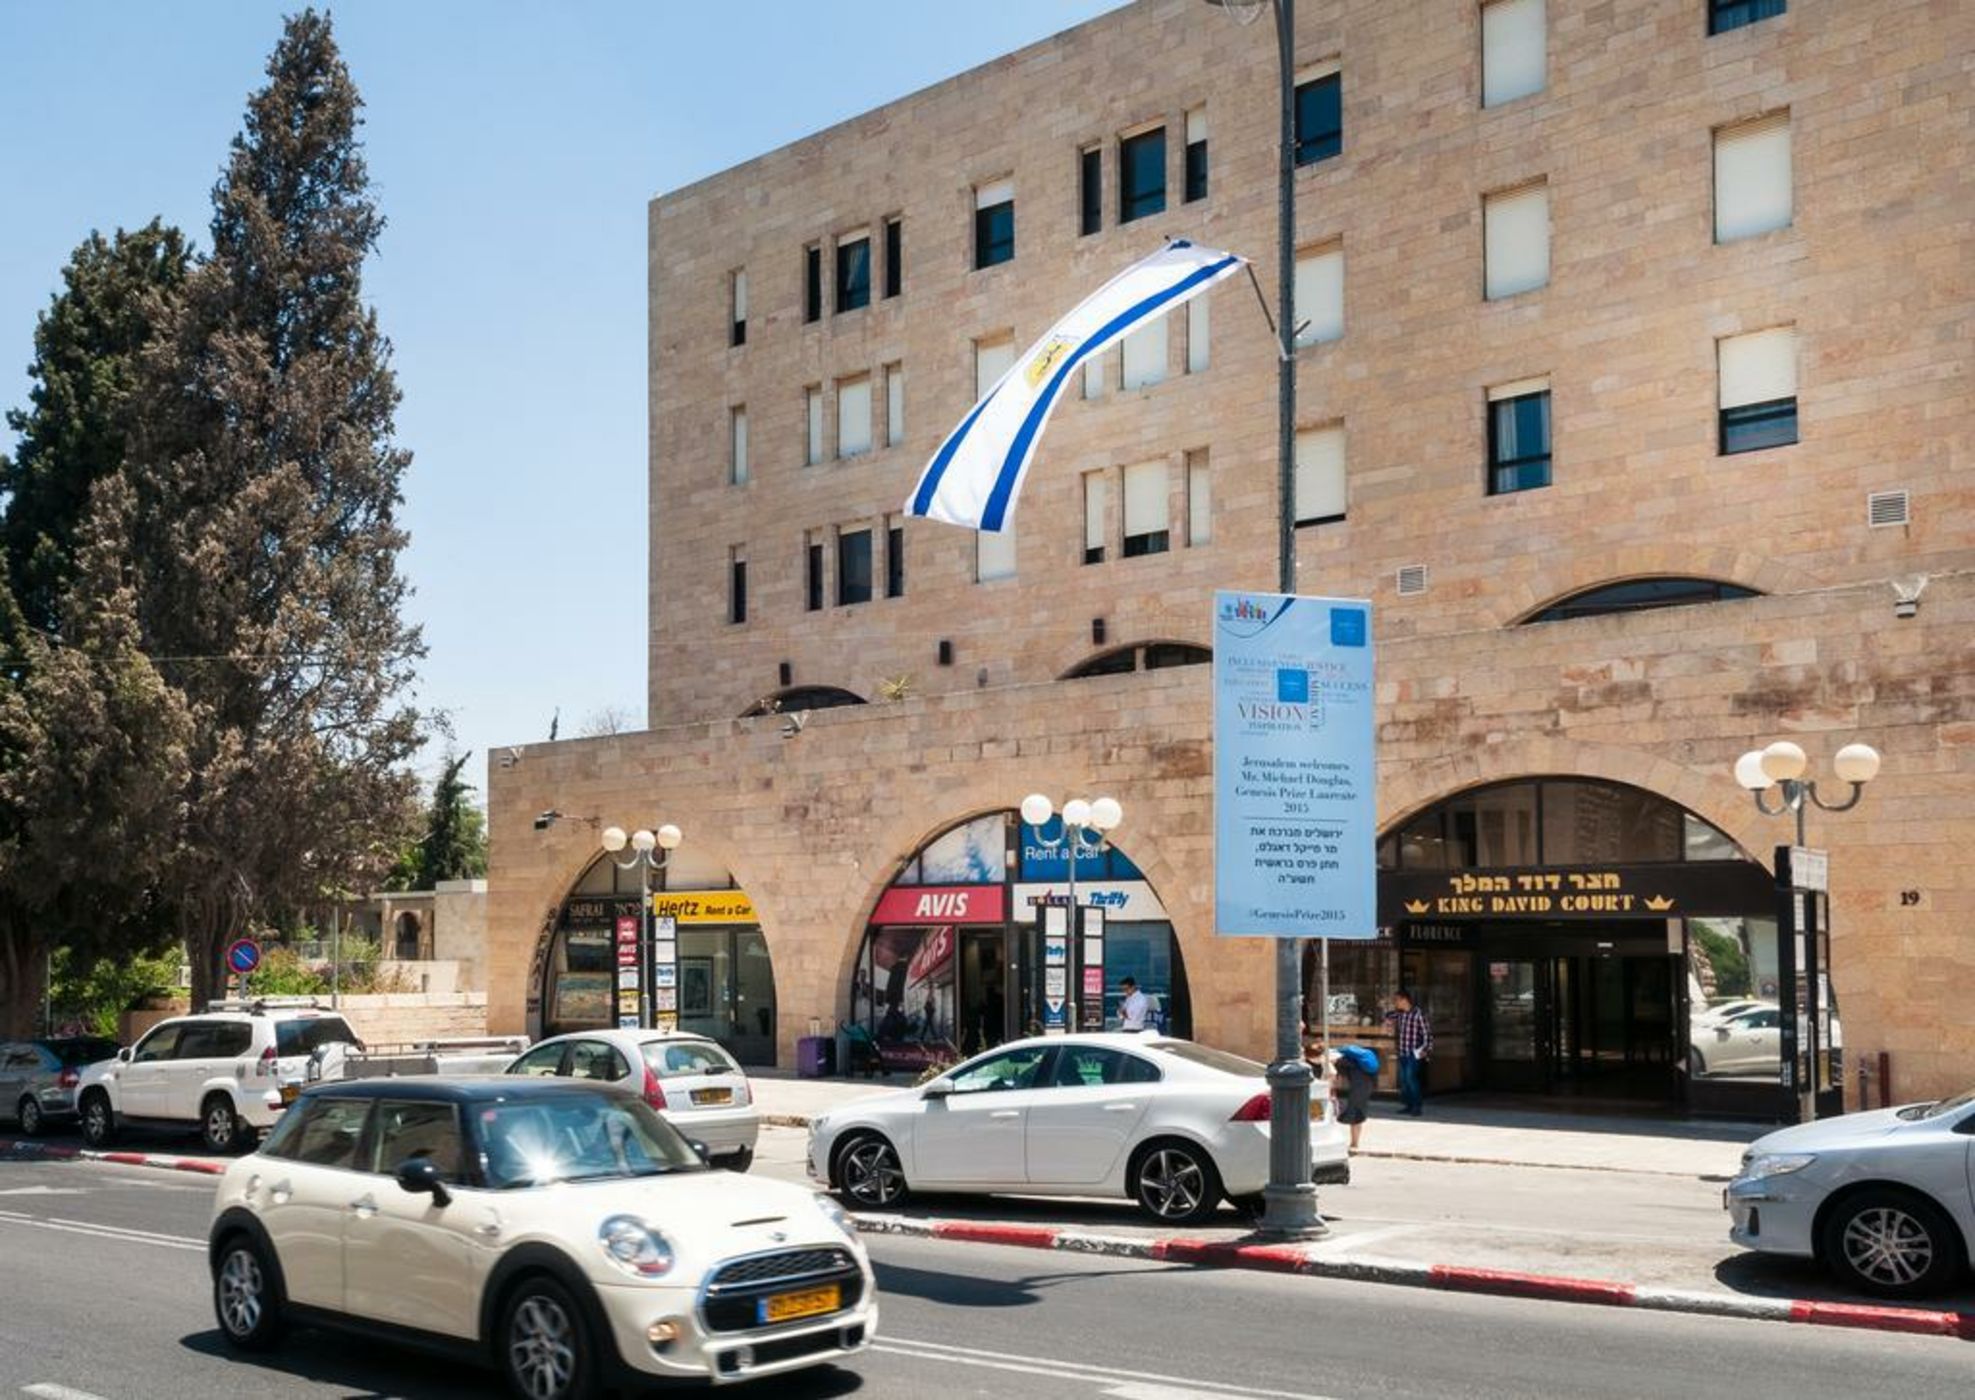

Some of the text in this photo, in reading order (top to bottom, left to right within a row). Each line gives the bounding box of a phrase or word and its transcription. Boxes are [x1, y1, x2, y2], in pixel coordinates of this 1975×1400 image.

[1238, 703, 1305, 720] VISION
[1242, 756, 1349, 771] Jerusalem welcomes
[1241, 771, 1352, 787] Mr. Michael Douglas,
[1235, 787, 1357, 800] Genesis Prize Laureate
[1284, 802, 1309, 813] 2015
[1251, 827, 1343, 839] ירושלים מברכת את
[1025, 846, 1100, 860] Rent a Car
[1294, 843, 1322, 854] מייקל
[1324, 845, 1338, 854] מר
[1255, 858, 1339, 870] חתן פרס בראשית
[1450, 873, 1621, 894] חצר דוד המלך
[915, 893, 969, 917] AVIS
[1090, 891, 1130, 909] Thrifty
[1437, 894, 1635, 913] KING DAVID COURT
[1900, 891, 1920, 906] 19
[659, 900, 752, 917] Hertz Rent a Car
